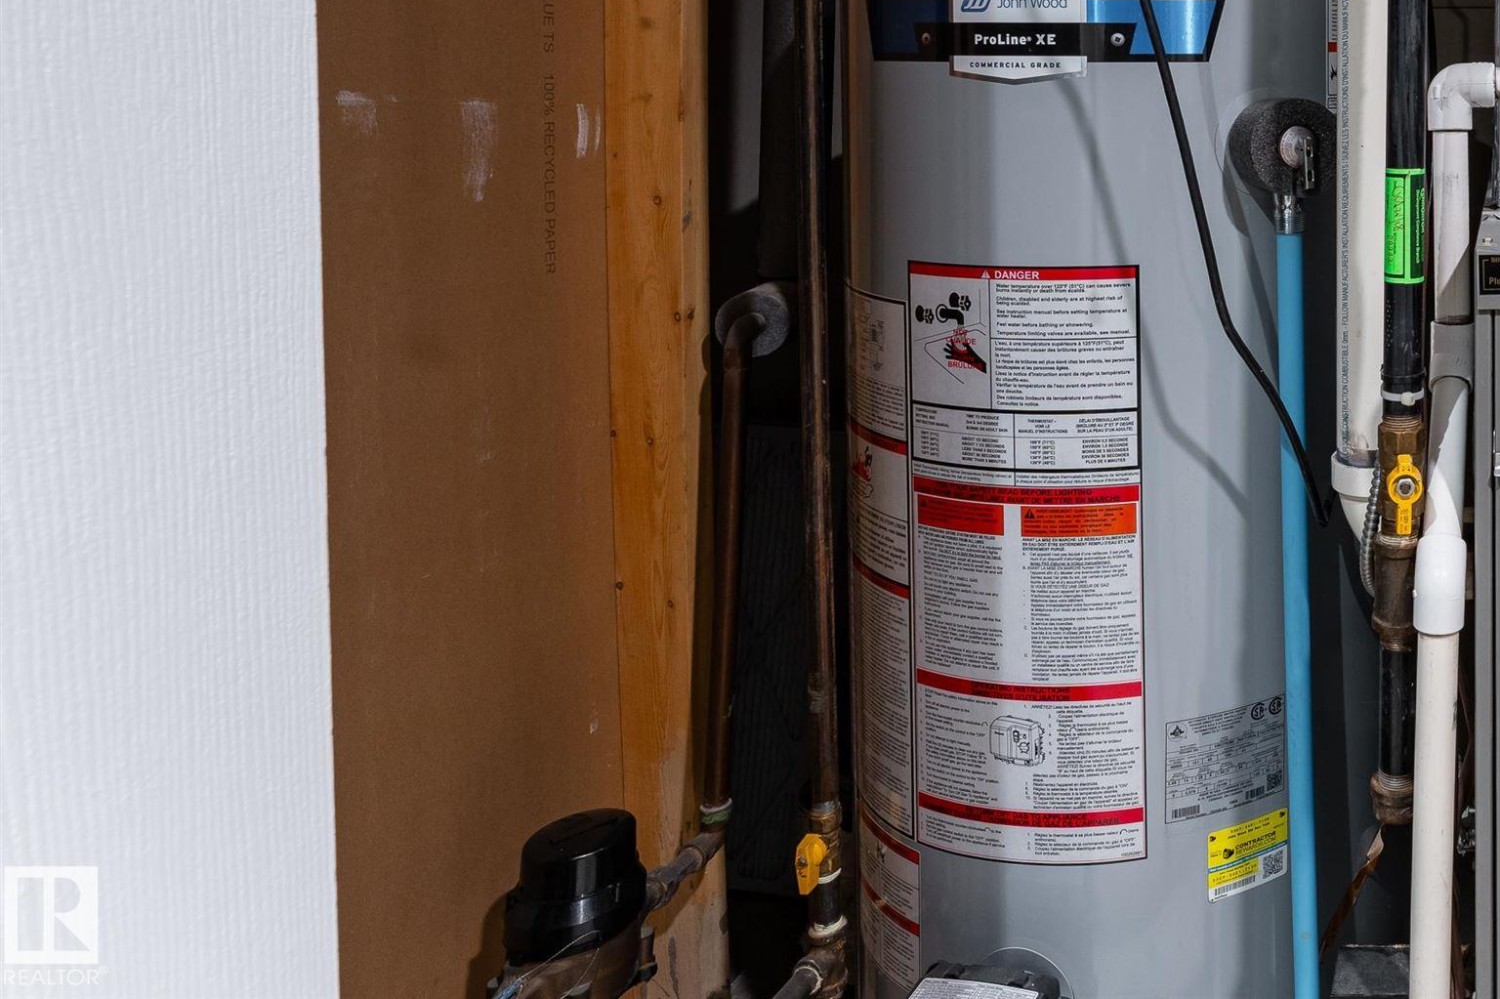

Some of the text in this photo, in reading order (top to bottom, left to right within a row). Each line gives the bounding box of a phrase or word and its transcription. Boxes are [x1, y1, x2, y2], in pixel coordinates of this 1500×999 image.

[543, 31, 555, 54] TS
[1035, 33, 1057, 46] XE
[969, 61, 1062, 69] COMMERCIAL GRADE
[543, 74, 556, 116] 100%
[1341, 86, 1350, 129] INSTRUCTIONS
[543, 121, 556, 214] RECYCLED
[1341, 164, 1350, 209] REQUIREMENTS
[544, 219, 557, 275] PAPER
[1341, 209, 1350, 250] INSTALLATION
[994, 270, 1040, 280] DANGER
[1341, 301, 1350, 326] FOLLOW
